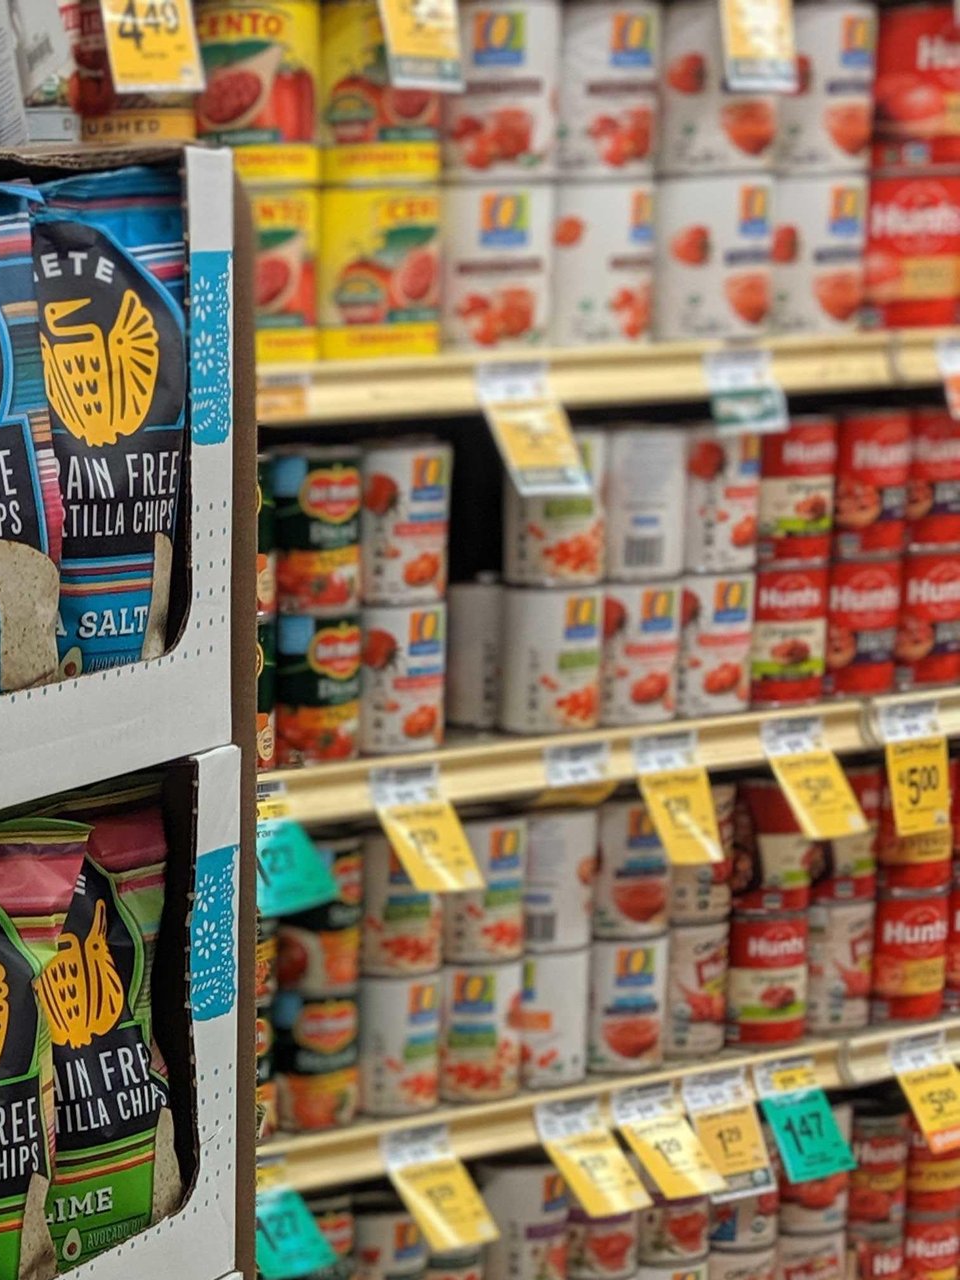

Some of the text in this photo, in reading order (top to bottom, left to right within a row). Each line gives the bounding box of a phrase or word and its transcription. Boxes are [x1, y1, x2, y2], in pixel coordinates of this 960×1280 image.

[86, 119, 161, 135] USHED
[41, 251, 116, 284] ETE
[125, 450, 181, 498] FREE
[133, 498, 175, 534] CHIPS
[79, 605, 149, 639] SALT
[54, 1057, 92, 1103] AIN
[55, 1097, 112, 1134] TILLA
